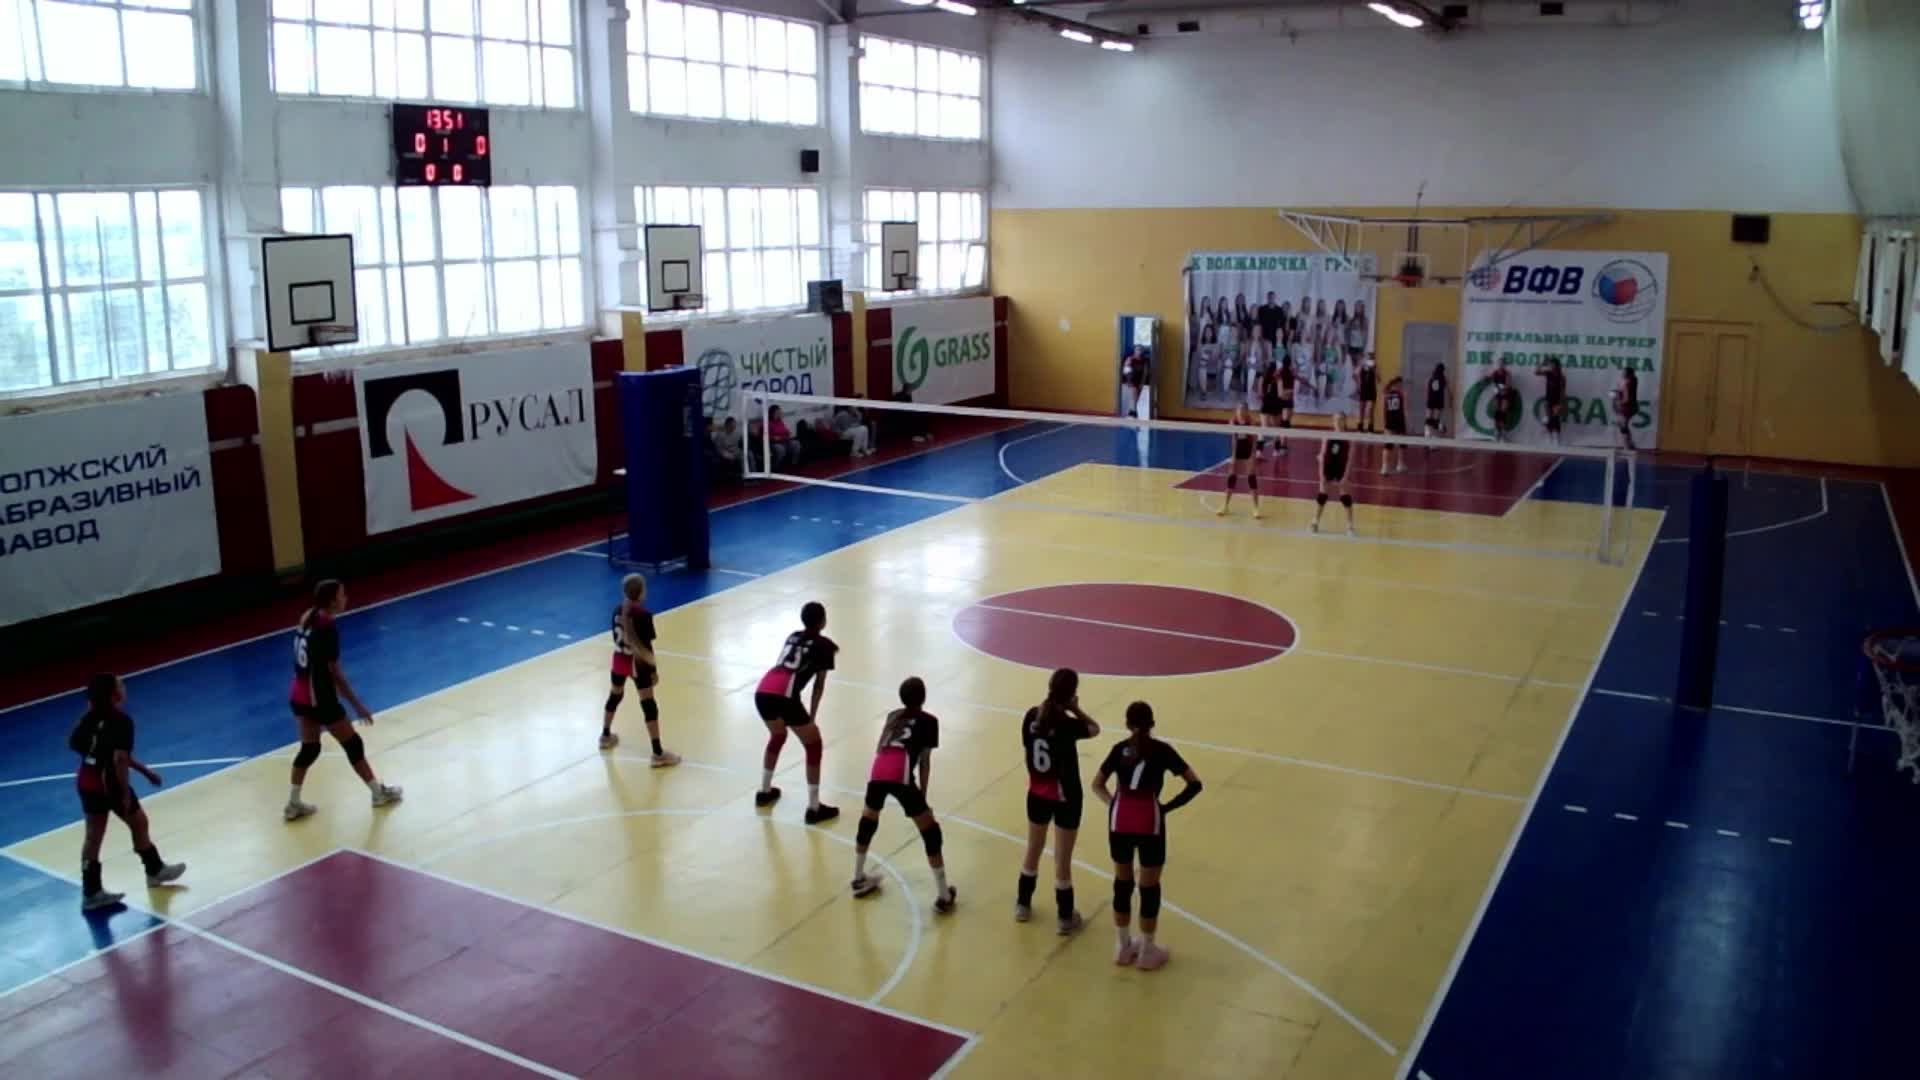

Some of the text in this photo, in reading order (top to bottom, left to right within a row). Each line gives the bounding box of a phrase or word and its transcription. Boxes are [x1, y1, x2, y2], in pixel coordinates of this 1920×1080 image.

[415, 132, 486, 155] 0 1 0
[1503, 265, 1585, 295] ВФВ
[741, 337, 827, 376] ЧИСТЫЙ
[934, 332, 991, 368] GRASS
[1465, 351, 1493, 365] ВК
[470, 388, 586, 440] РУСАЛ
[0, 444, 168, 494] ОЛЖСКИЙ
[0, 465, 201, 526] БРАЗИВНЫЙ
[1032, 738, 1051, 773] 6
